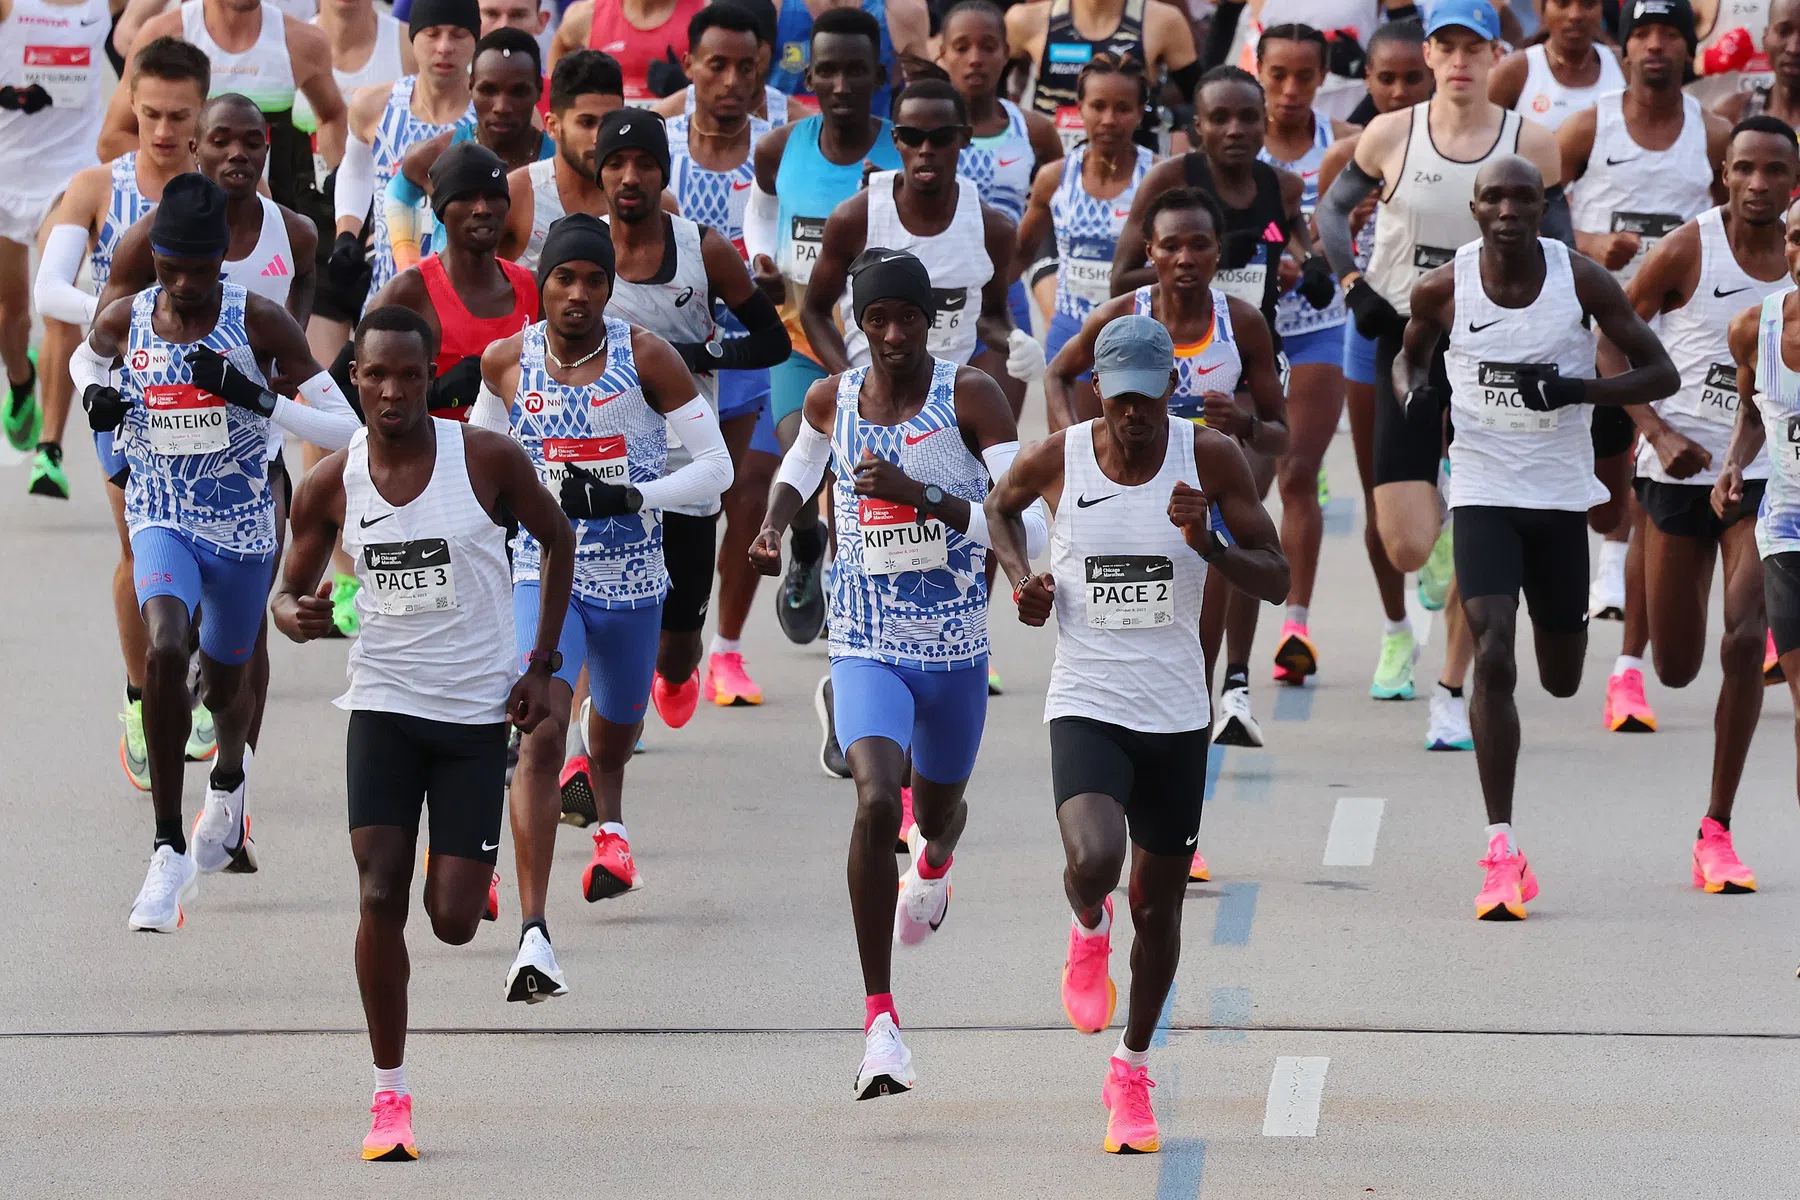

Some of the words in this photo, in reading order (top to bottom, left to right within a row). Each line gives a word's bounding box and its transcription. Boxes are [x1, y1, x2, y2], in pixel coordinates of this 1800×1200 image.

[796, 244, 817, 261] PA
[950, 313, 959, 328] 6
[547, 398, 561, 407] NN
[1484, 389, 1522, 408] PAC
[151, 412, 222, 430] MATEIKO
[549, 464, 625, 481] MOMED
[864, 523, 942, 548] KIPTUM
[375, 570, 428, 590] PACE
[434, 568, 447, 586] 3
[1093, 585, 1149, 604] PACE
[1156, 583, 1168, 601] 2
